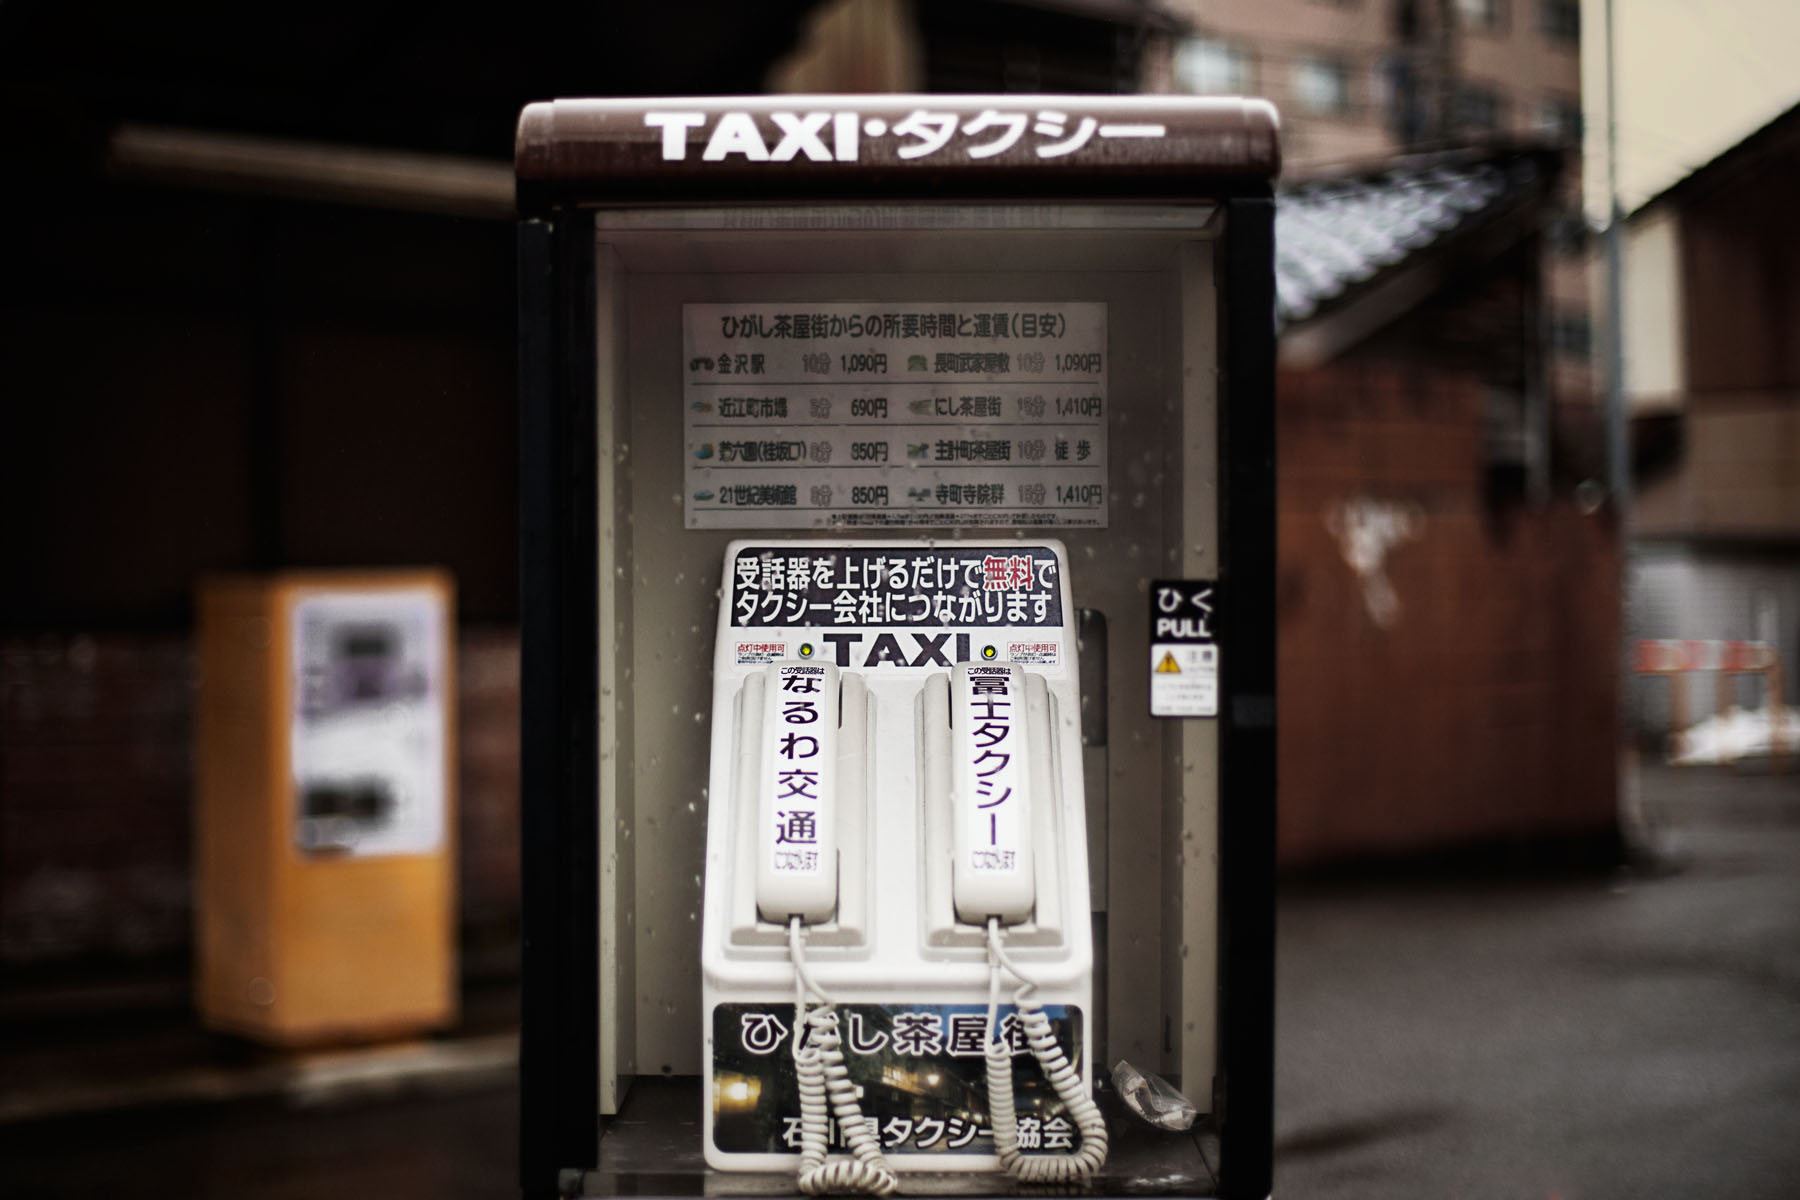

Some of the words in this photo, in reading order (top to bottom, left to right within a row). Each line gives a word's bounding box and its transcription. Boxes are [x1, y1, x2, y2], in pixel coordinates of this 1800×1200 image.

[718, 353, 765, 374] 金沢駅
[841, 353, 888, 374] 1,090円
[1055, 353, 1102, 374] 1,090円
[718, 396, 788, 418] 近江町市場
[851, 397, 888, 418] 690円
[935, 396, 1002, 417] にし茶屋街
[1055, 396, 1102, 417] 1,410円
[852, 485, 889, 506] 850円
[935, 483, 1005, 505] 寺町寺院群
[1056, 484, 1102, 505] 1,410円
[736, 590, 1052, 624] タクシー会社につながります
[1157, 588, 1213, 612] ひく
[1157, 618, 1212, 637] PULL
[823, 633, 971, 667] TAXI
[776, 675, 822, 844] なるわ交通
[970, 676, 1012, 845] 富士タクシー
